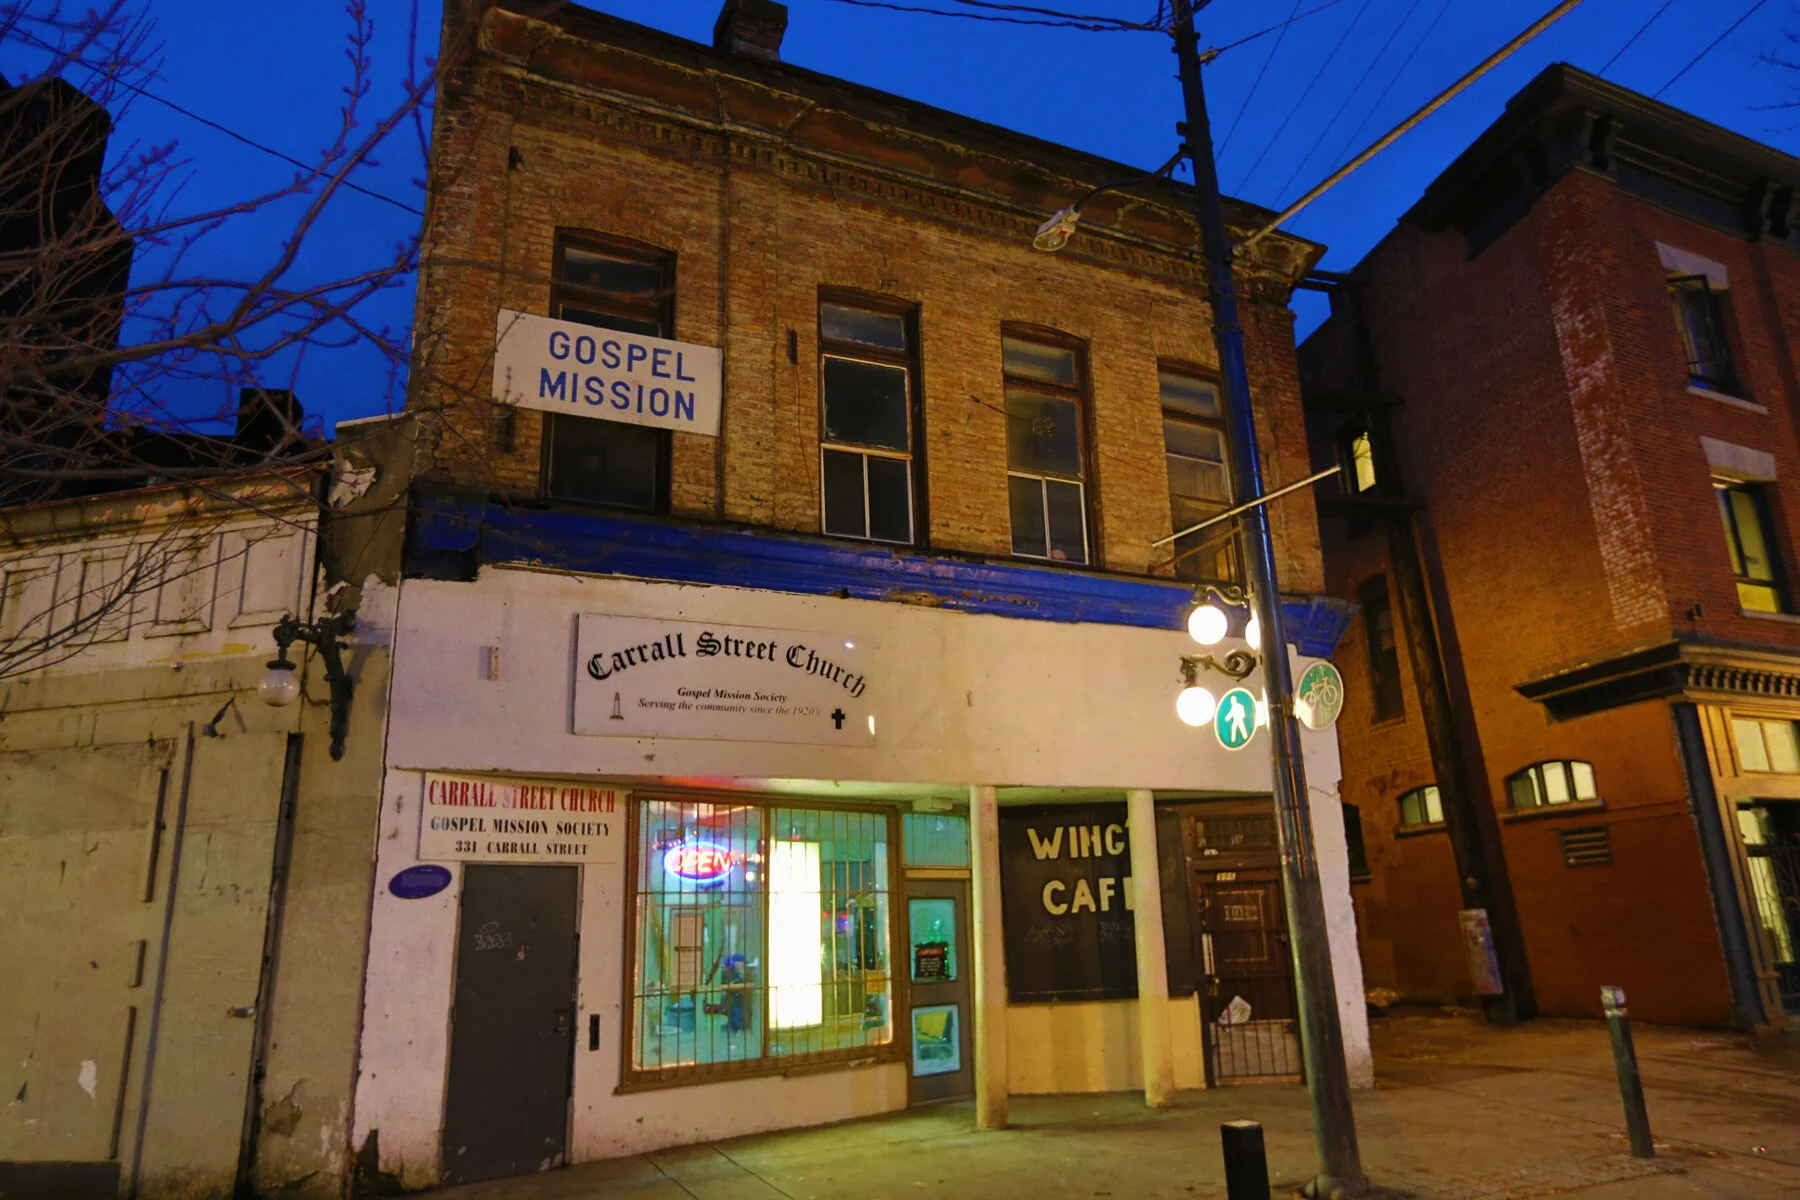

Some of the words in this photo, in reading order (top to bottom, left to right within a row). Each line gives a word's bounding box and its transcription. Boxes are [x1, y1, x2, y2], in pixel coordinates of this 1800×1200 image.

[549, 330, 696, 383] GOSPEL
[539, 367, 695, 421] MISSION
[587, 633, 687, 681] Carrall
[696, 631, 778, 662] Street
[785, 645, 867, 699] Church
[637, 698, 676, 711] Serving
[678, 700, 692, 711] the
[695, 702, 747, 714] community
[750, 704, 773, 715] since
[775, 705, 790, 716] the
[677, 687, 711, 700] Gospel
[713, 689, 751, 702] Mission
[753, 691, 788, 704] Society
[429, 779, 496, 808] CARRALL
[503, 784, 557, 811] STREET
[561, 787, 615, 813] CHURCH
[431, 816, 487, 833] GOSPEL
[493, 818, 548, 835] MISSION
[556, 821, 610, 837] SOCIETY
[455, 839, 477, 854] 331
[487, 841, 539, 855] CARRALL
[546, 843, 588, 856] STREET
